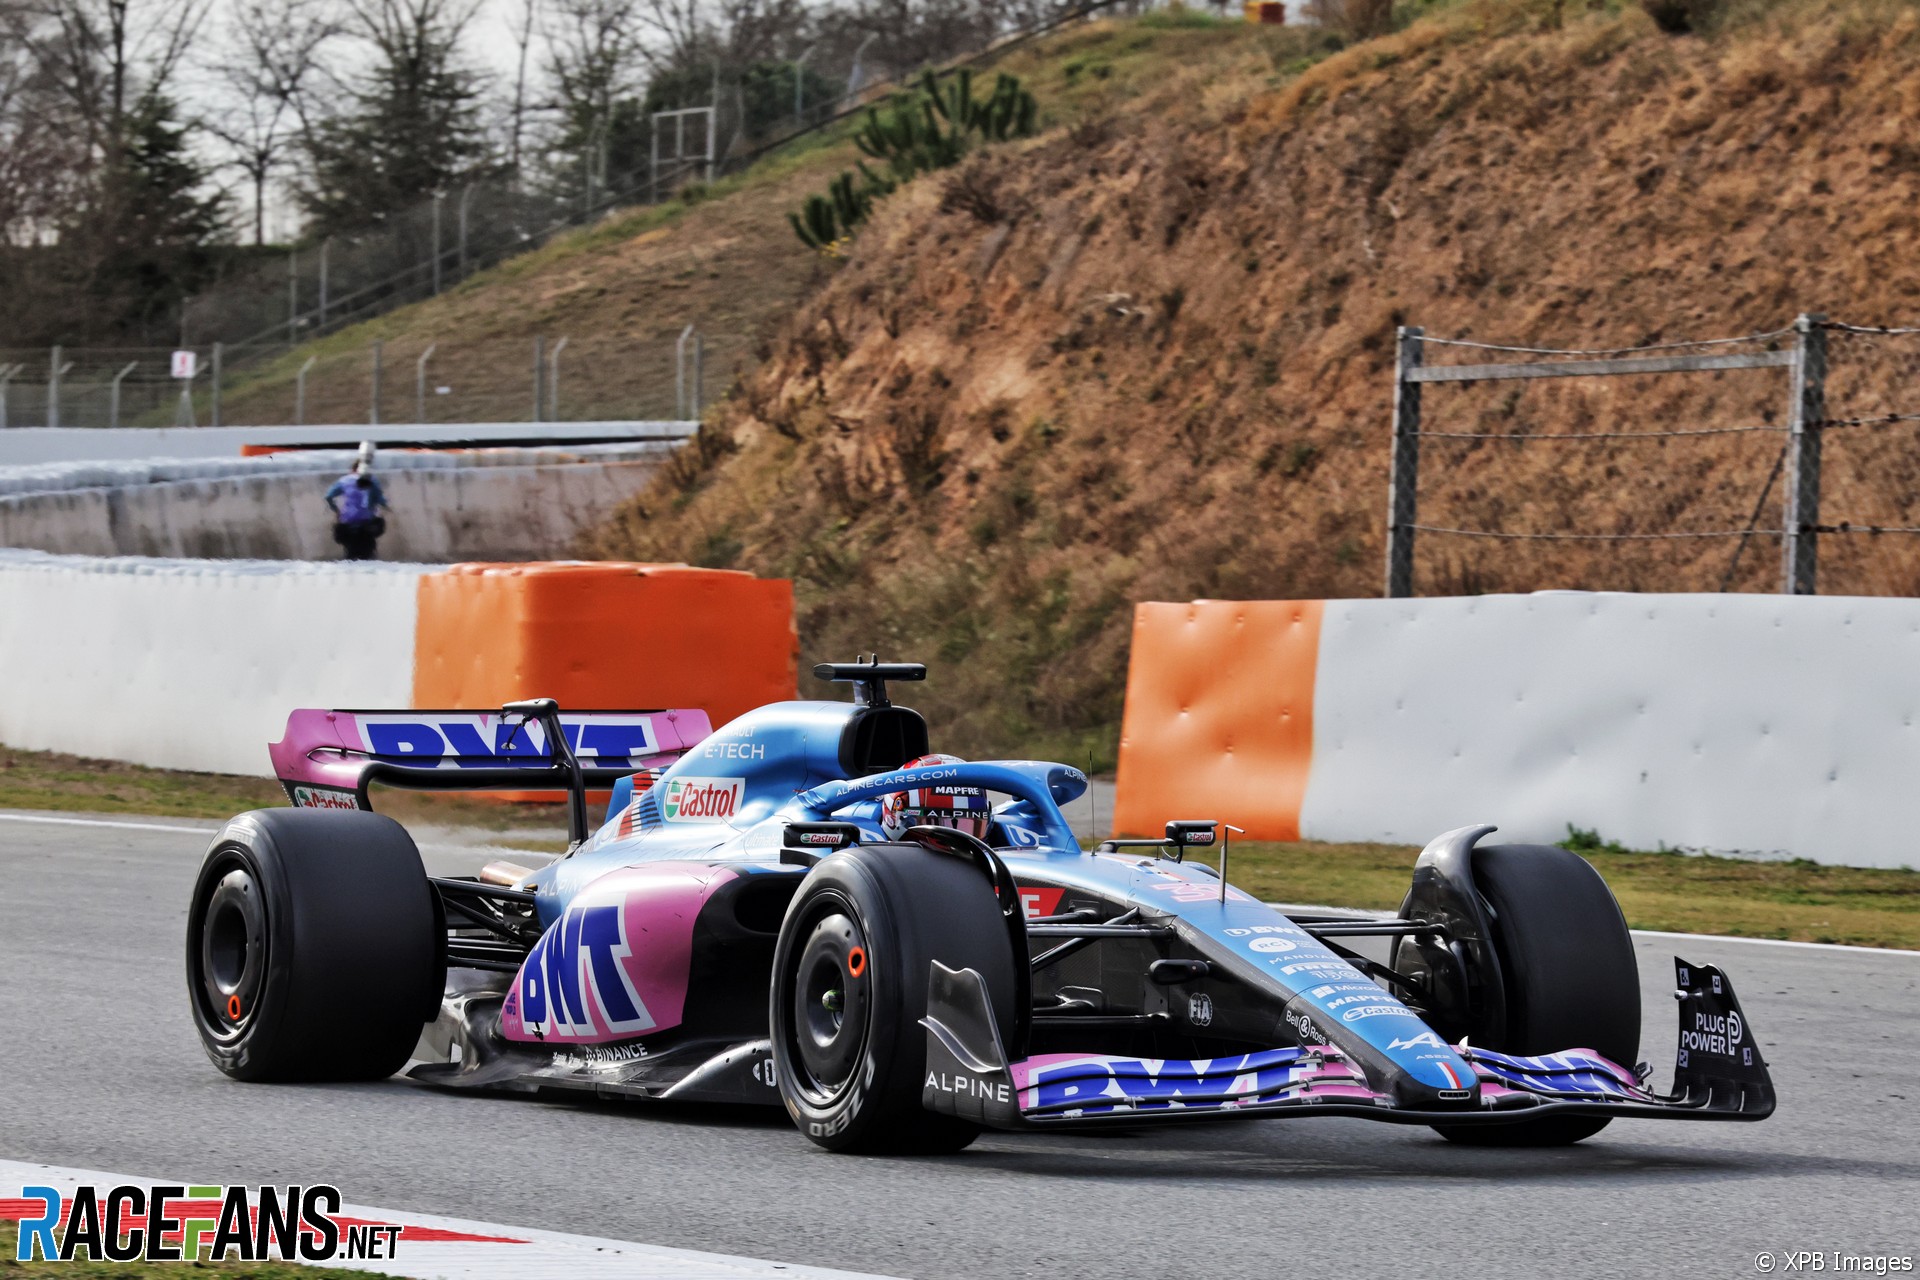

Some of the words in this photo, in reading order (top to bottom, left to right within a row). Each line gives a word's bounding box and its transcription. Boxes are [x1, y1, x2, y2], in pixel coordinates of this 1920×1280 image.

[360, 716, 656, 769] BWT
[836, 768, 958, 797] ALPINECARS.COM
[935, 786, 979, 796] MAPFRE
[679, 782, 738, 817] Castrol
[927, 809, 988, 819] ALPINE
[810, 834, 840, 844] Castrol
[1192, 833, 1212, 842] Castrol
[521, 898, 652, 1031] BWT
[1285, 1009, 1300, 1030] Bell
[1310, 1025, 1327, 1046] Ross
[1695, 1012, 1726, 1034] PLUG
[596, 1043, 648, 1062] BINANCE
[1681, 1030, 1726, 1055] POWER
[925, 1070, 1010, 1103] ALPINE
